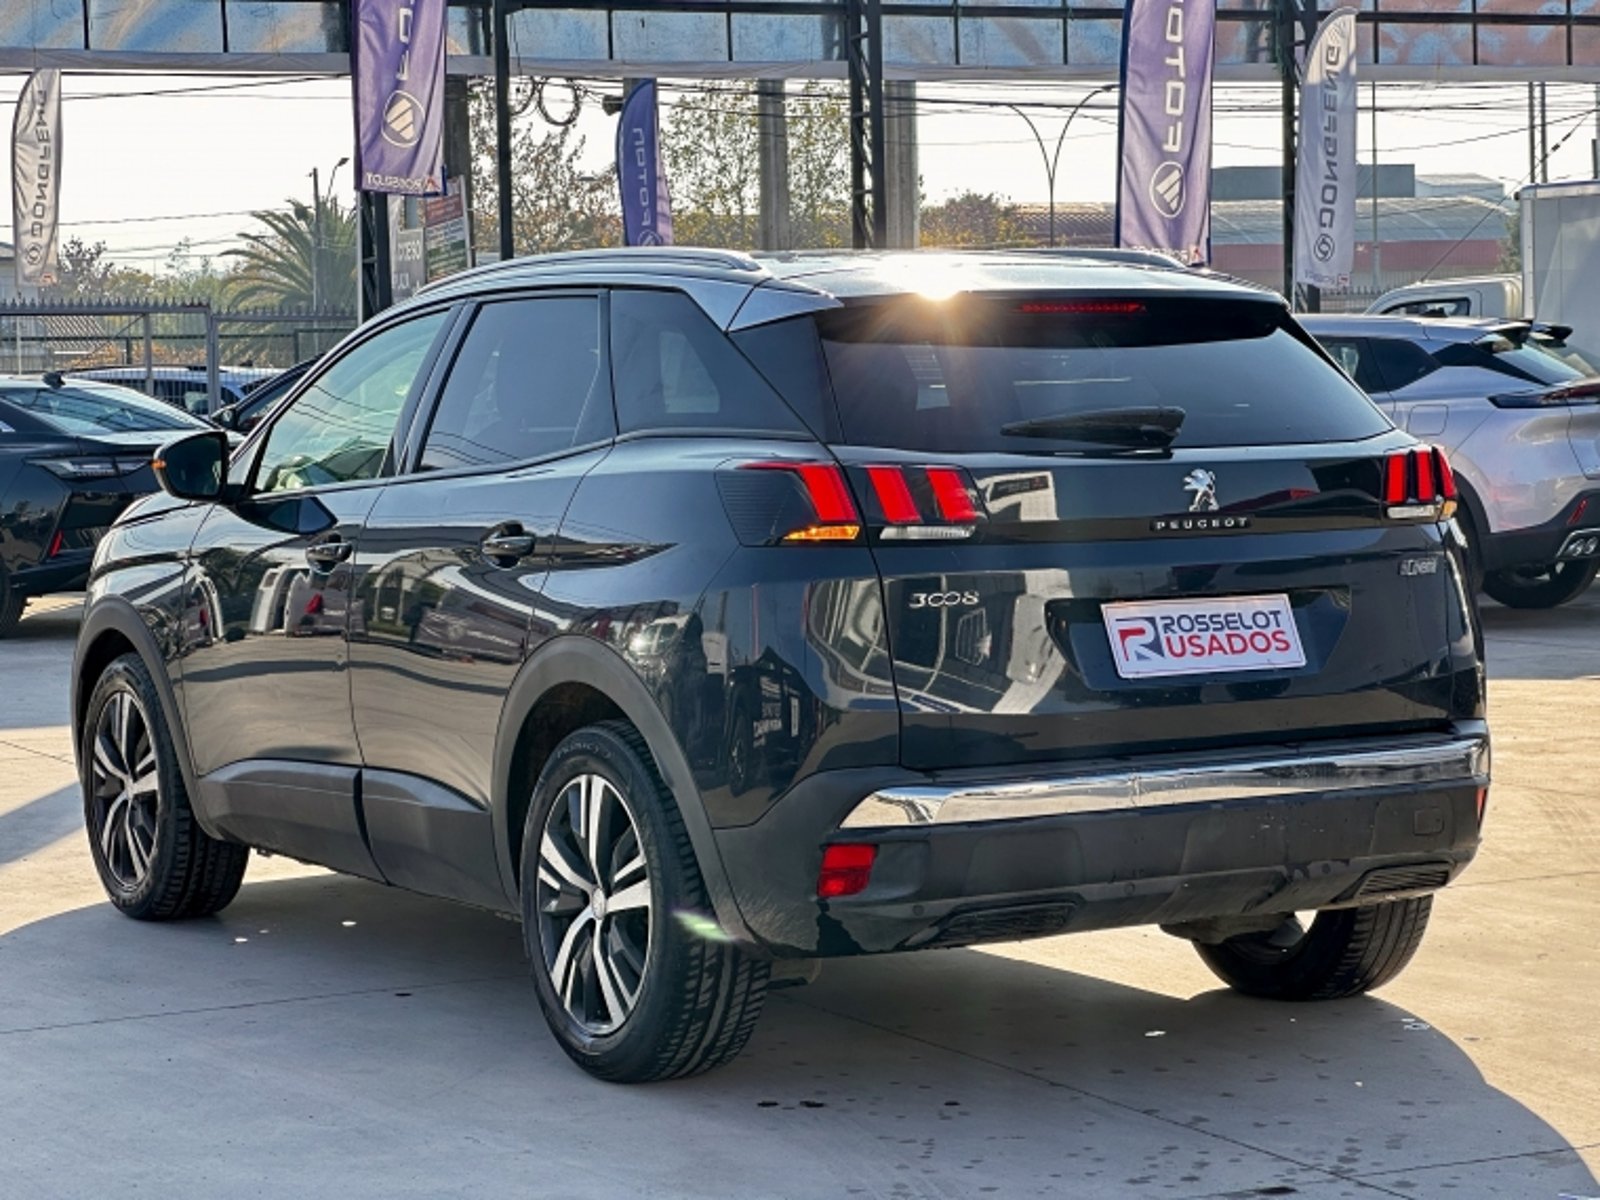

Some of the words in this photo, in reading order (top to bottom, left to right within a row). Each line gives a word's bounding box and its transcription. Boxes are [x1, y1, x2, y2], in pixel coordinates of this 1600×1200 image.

[1156, 517, 1247, 530] PEUGEOT
[909, 590, 979, 609] 3008
[1160, 610, 1281, 635] ROSSELOT
[1165, 630, 1291, 659] USADOS
